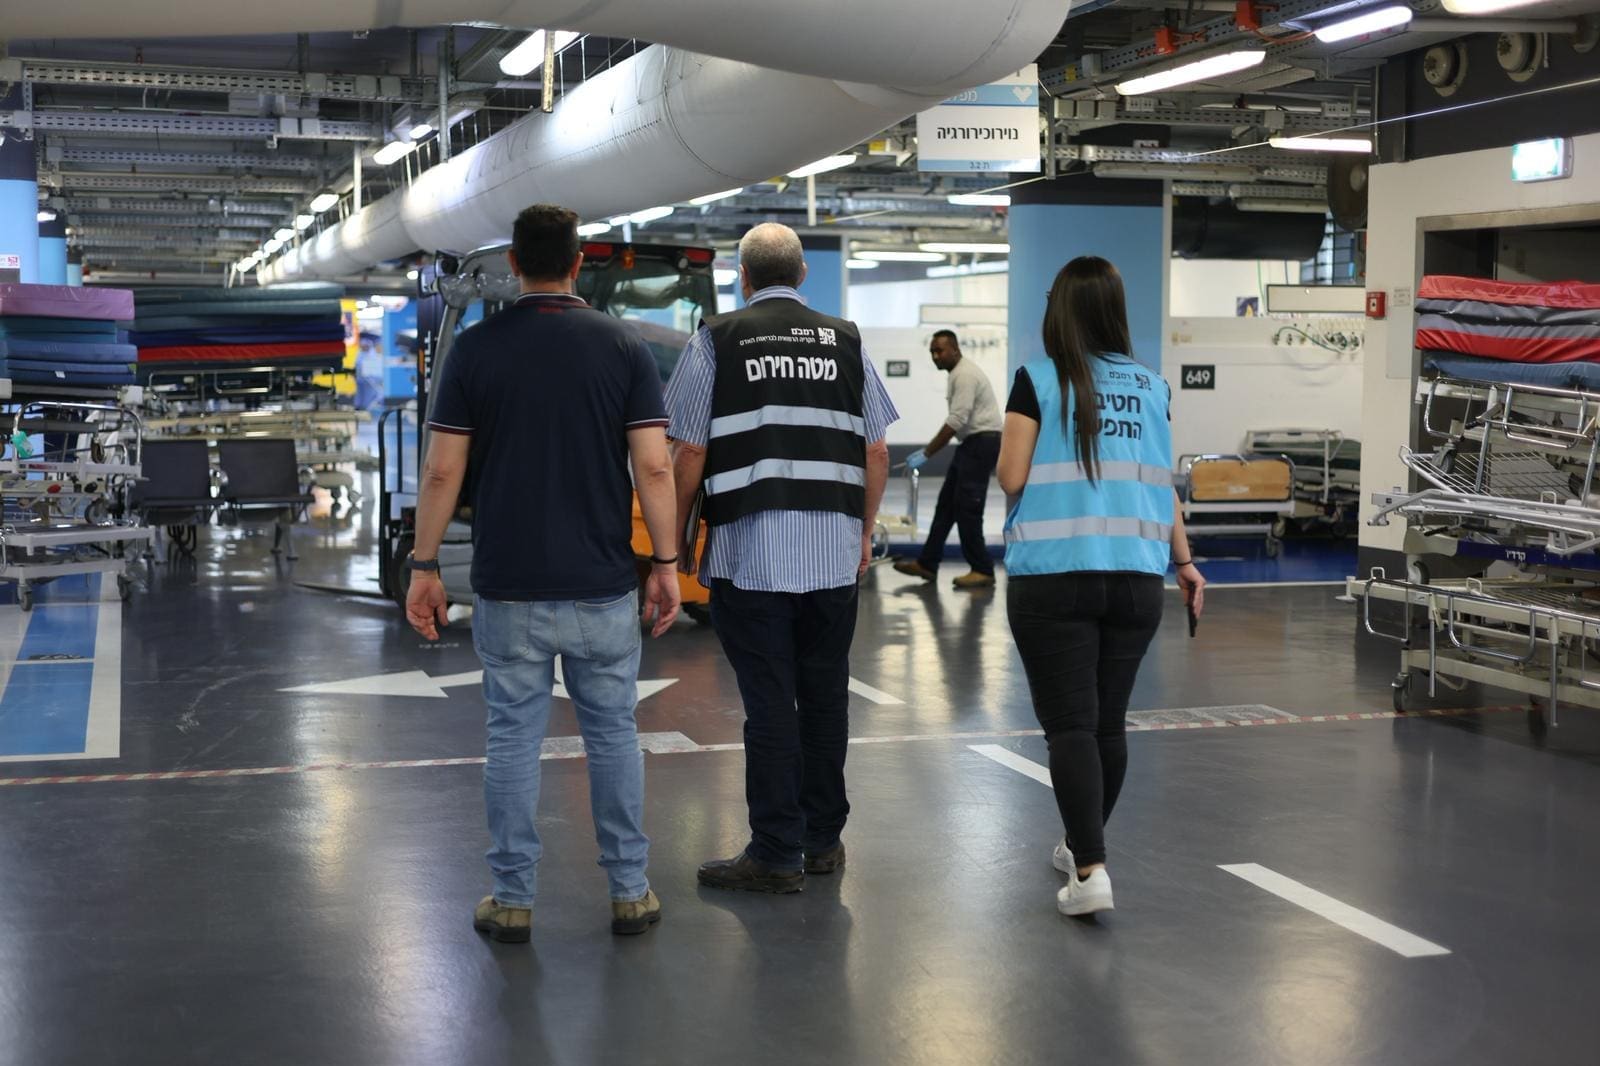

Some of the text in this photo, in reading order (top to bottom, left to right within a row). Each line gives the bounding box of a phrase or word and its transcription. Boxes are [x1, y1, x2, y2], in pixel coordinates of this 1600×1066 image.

[937, 127, 1019, 140] נוירוכירורגיה
[745, 355, 838, 382] מטה חירום
[1186, 370, 1211, 385] 649
[1094, 392, 1141, 414] חטיב
